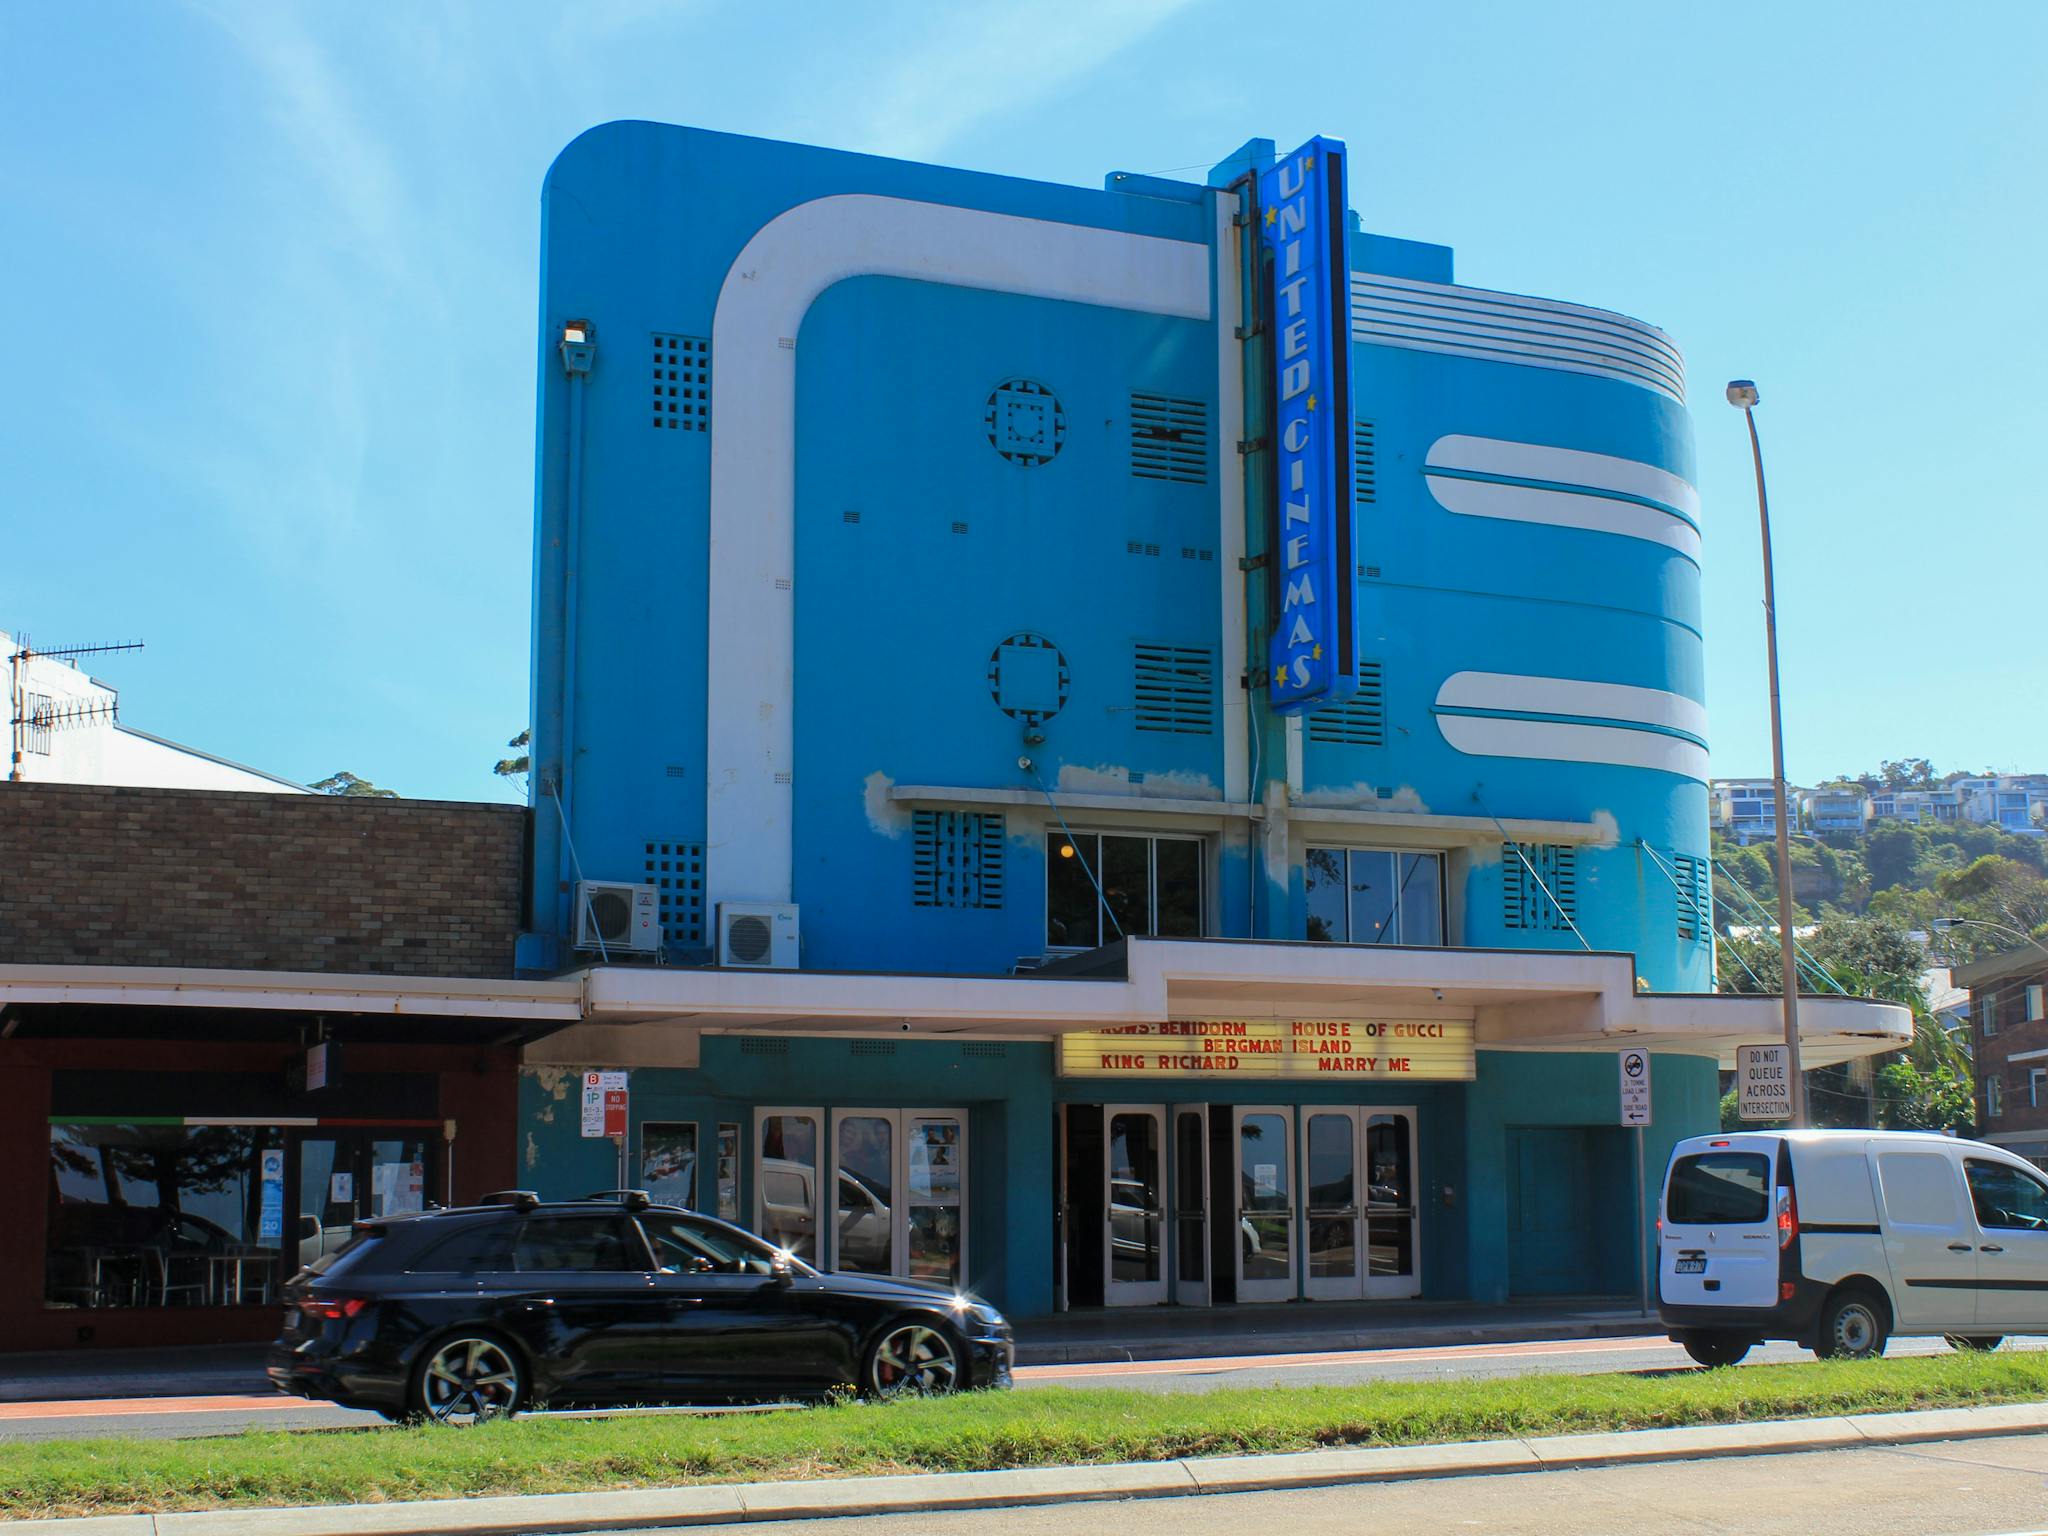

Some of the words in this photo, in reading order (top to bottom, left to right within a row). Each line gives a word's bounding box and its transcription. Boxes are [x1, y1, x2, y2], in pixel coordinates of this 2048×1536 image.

[1279, 156, 1310, 400] UNITED
[1283, 419, 1316, 689] CINEMAS
[1292, 1022, 1351, 1037] HOUSE
[1366, 1023, 1387, 1037] OF
[1394, 1024, 1443, 1038] GUCCI
[1204, 1039, 1282, 1053] BERGMAN
[1293, 1040, 1352, 1054] ISLAND
[1102, 1055, 1145, 1069] KING
[1159, 1055, 1239, 1070] RICHARD
[1319, 1058, 1377, 1072] MARRY
[1389, 1058, 1411, 1072] ME
[1750, 1051, 1761, 1063] DO
[1763, 1050, 1779, 1063] NOT
[1749, 1067, 1783, 1080] QUEUE
[1746, 1084, 1786, 1097] ACROSS
[611, 1095, 621, 1103] NO
[1740, 1101, 1790, 1114] INTERSECTION
